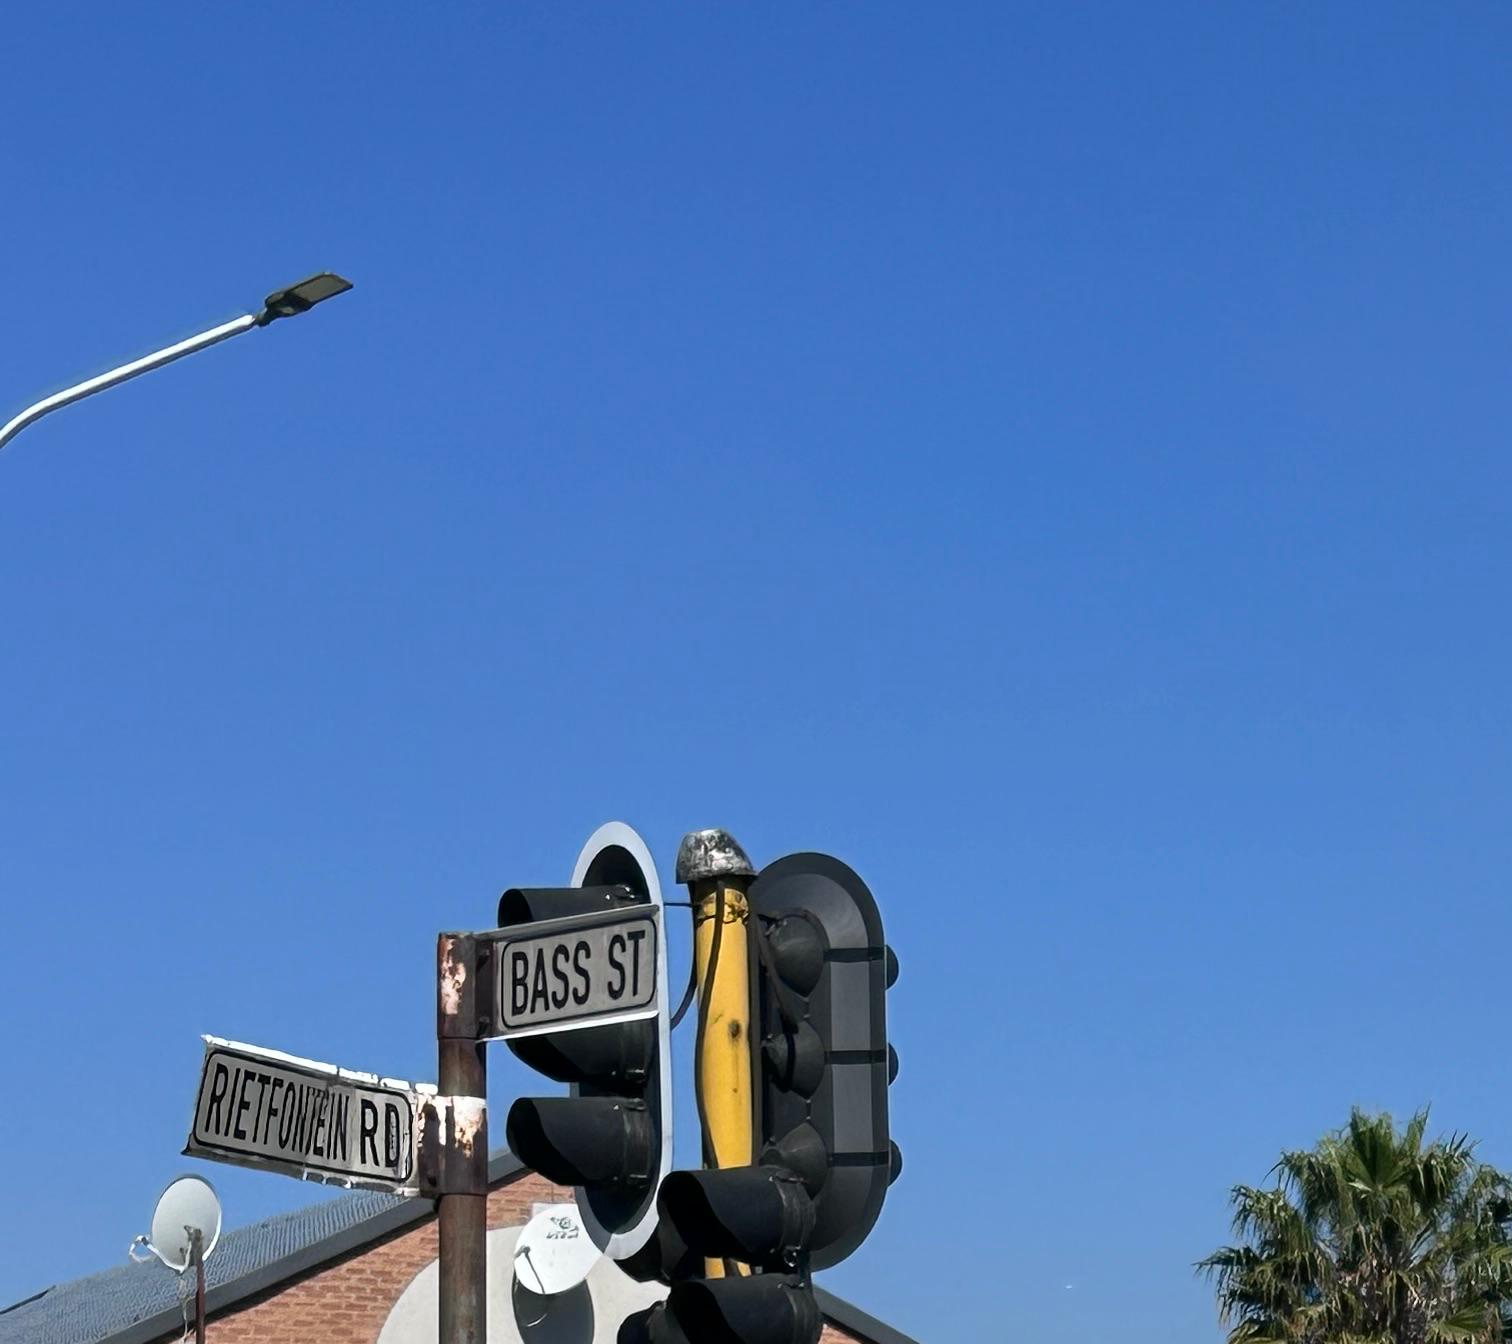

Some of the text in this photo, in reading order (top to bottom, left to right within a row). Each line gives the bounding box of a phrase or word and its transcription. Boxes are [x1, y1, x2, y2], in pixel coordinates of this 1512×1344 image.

[511, 929, 646, 1017] BASS ST
[360, 1098, 401, 1168] RD
